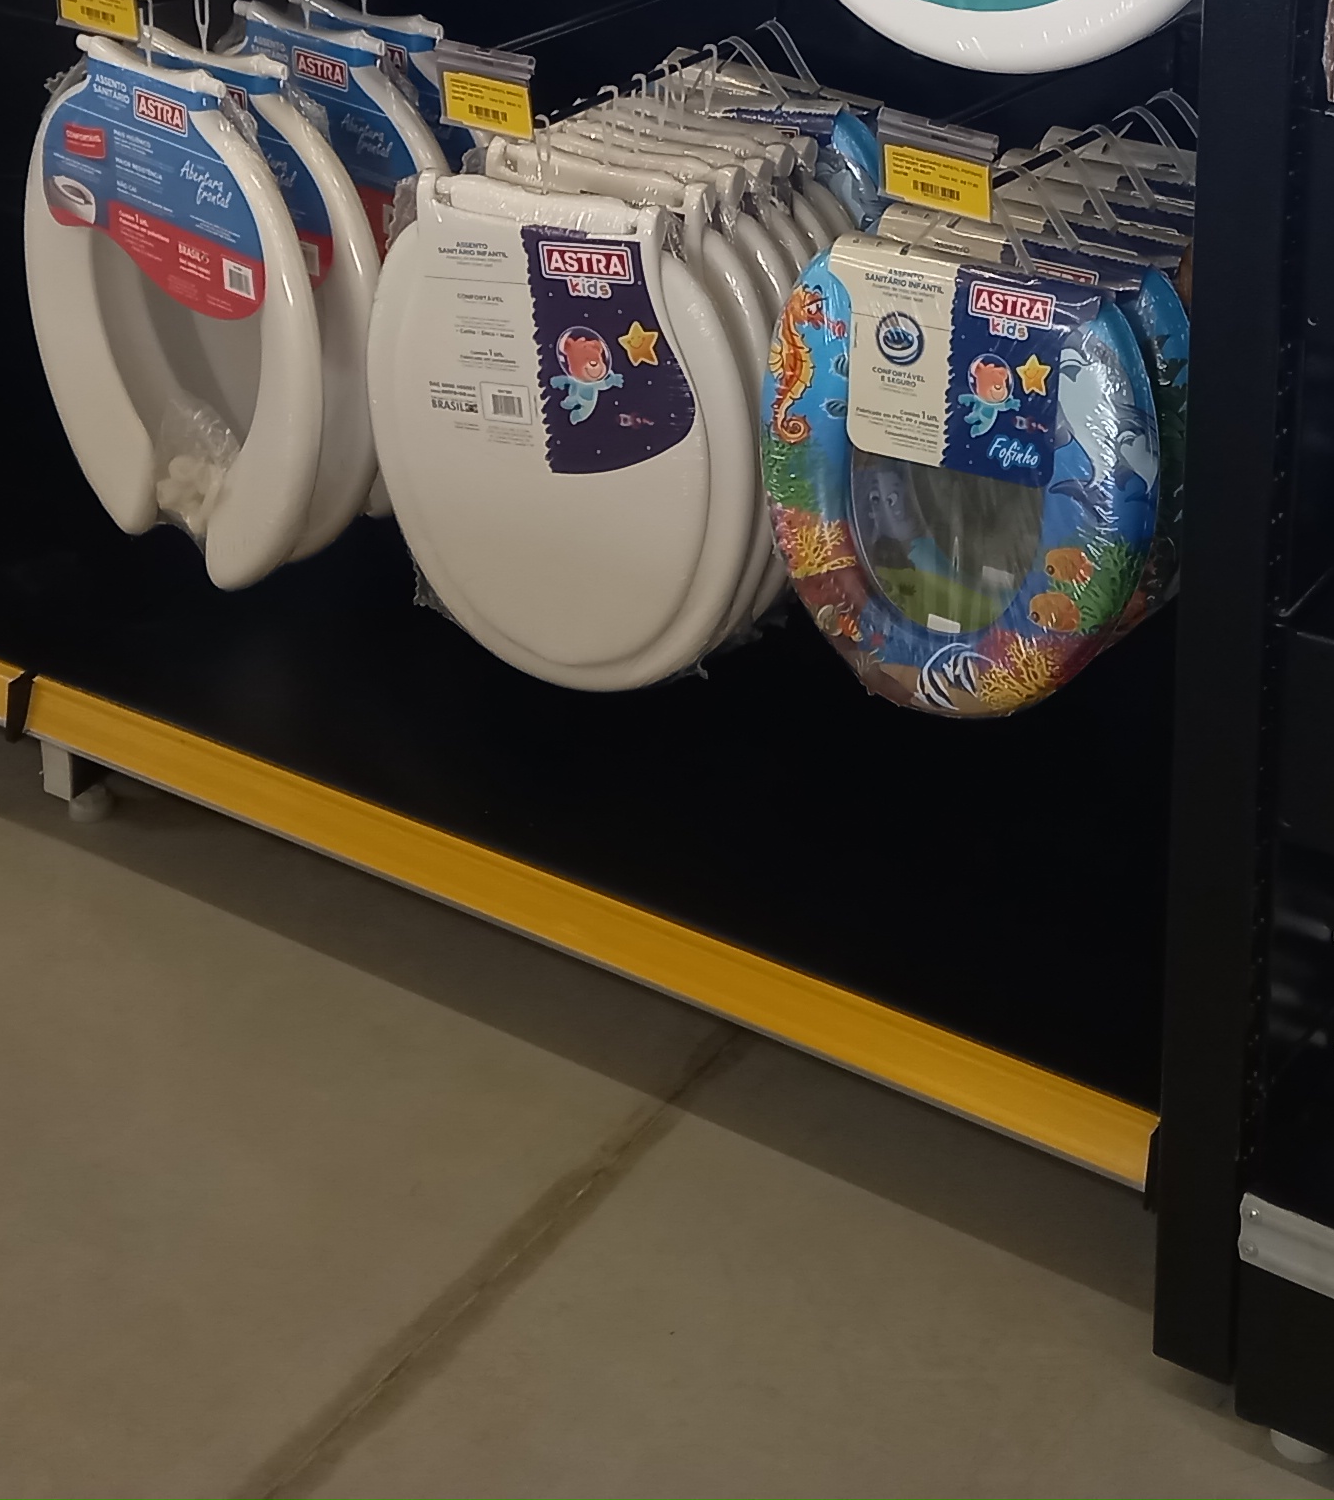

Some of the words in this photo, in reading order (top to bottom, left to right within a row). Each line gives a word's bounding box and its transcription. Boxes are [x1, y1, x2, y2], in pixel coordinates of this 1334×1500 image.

[295, 52, 346, 85] ASTRA
[92, 83, 131, 105] SANITÁRIO
[94, 73, 127, 93] ASSENTO
[137, 98, 185, 130] ASTRA
[180, 159, 224, 192] Abertura
[196, 185, 233, 209] frontal
[456, 241, 488, 250] ASSENTO
[549, 251, 625, 276] ASTRA
[569, 277, 609, 296] kids
[865, 272, 907, 287] SANITÁRIO
[908, 281, 945, 295] INFANTIL
[976, 291, 1046, 321] ASTRA
[991, 318, 1026, 338] kids
[872, 366, 925, 383] CONFORTÁVEL
[887, 377, 917, 388] SEGURO
[431, 399, 464, 412] BRASIL
[988, 438, 1040, 466] Fofinho
